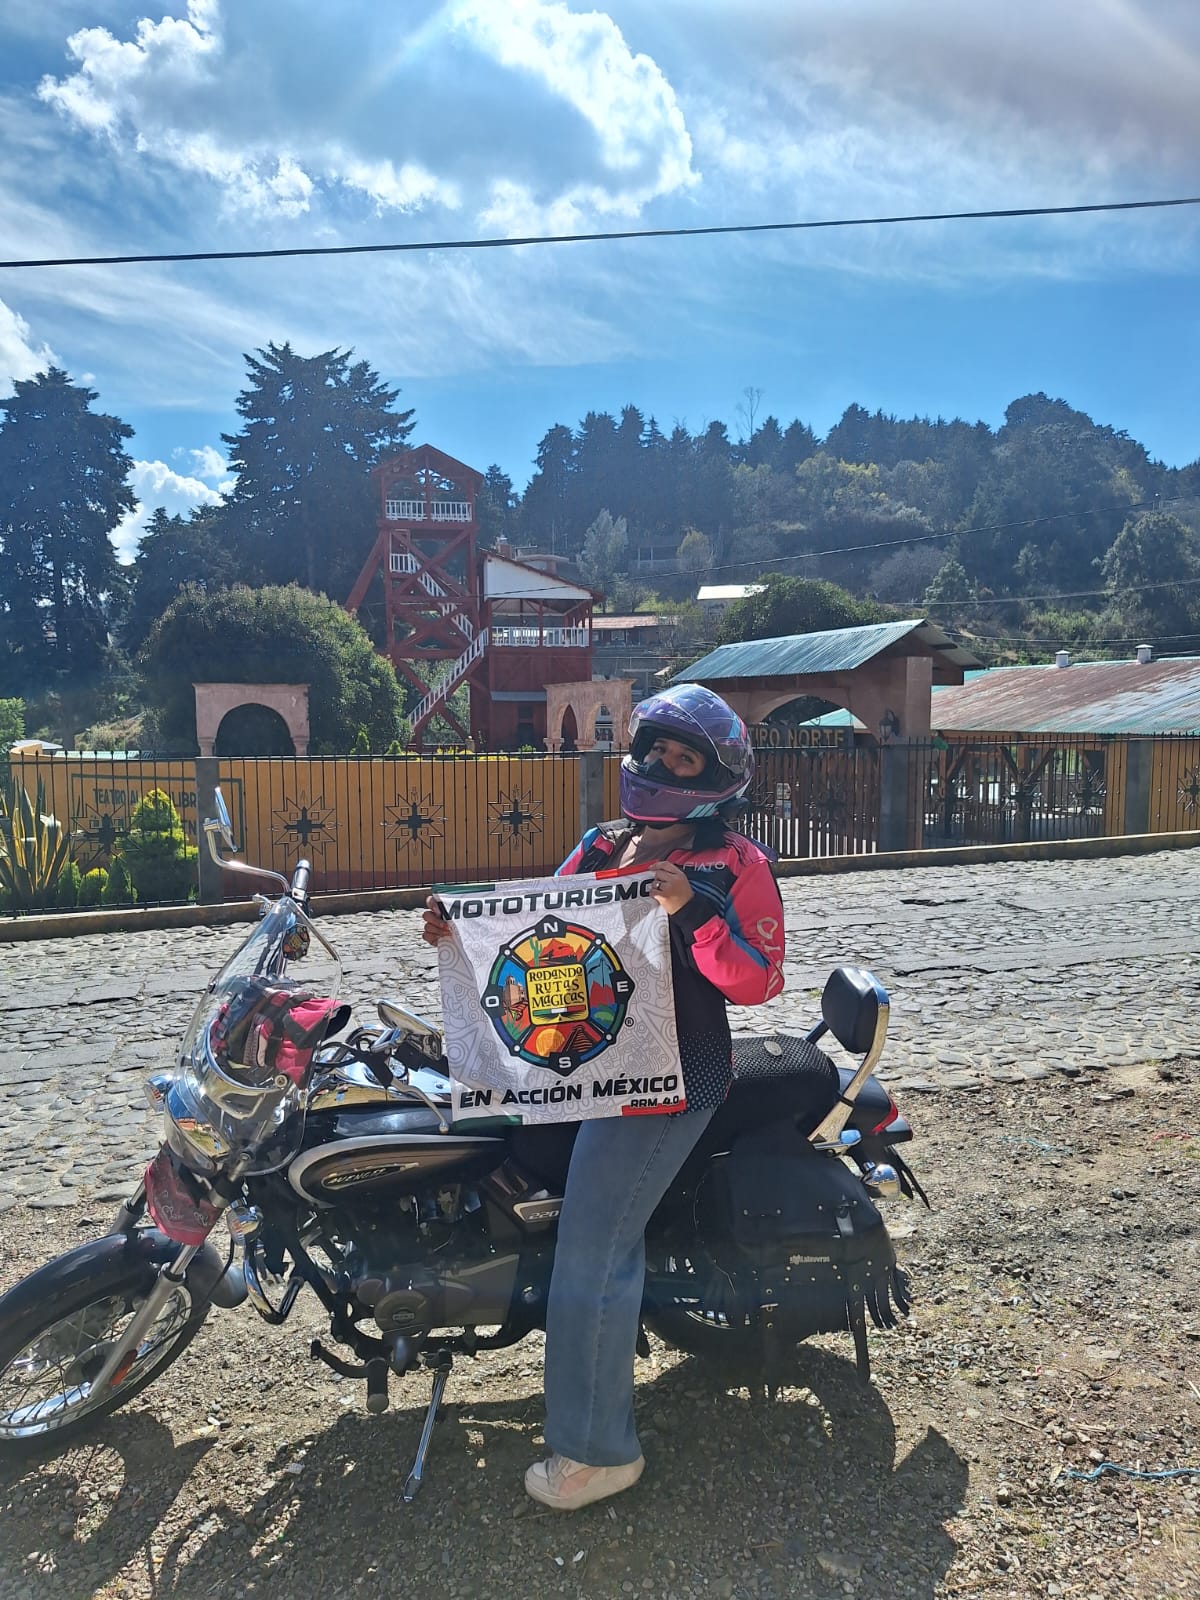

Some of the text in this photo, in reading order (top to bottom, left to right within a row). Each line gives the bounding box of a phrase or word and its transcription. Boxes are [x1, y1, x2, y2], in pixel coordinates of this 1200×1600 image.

[172, 791, 198, 808] LIBR
[682, 861, 726, 872] FIATO
[438, 878, 655, 921] MOTOTURISMO
[543, 921, 559, 934] N
[616, 980, 629, 993] E
[485, 995, 500, 1008] O
[558, 1056, 572, 1069] S
[460, 1072, 678, 1109] EN ACCIÓN MÉXICO
[630, 1095, 680, 1108] RRM 4.0
[528, 1210, 560, 1220] 220
